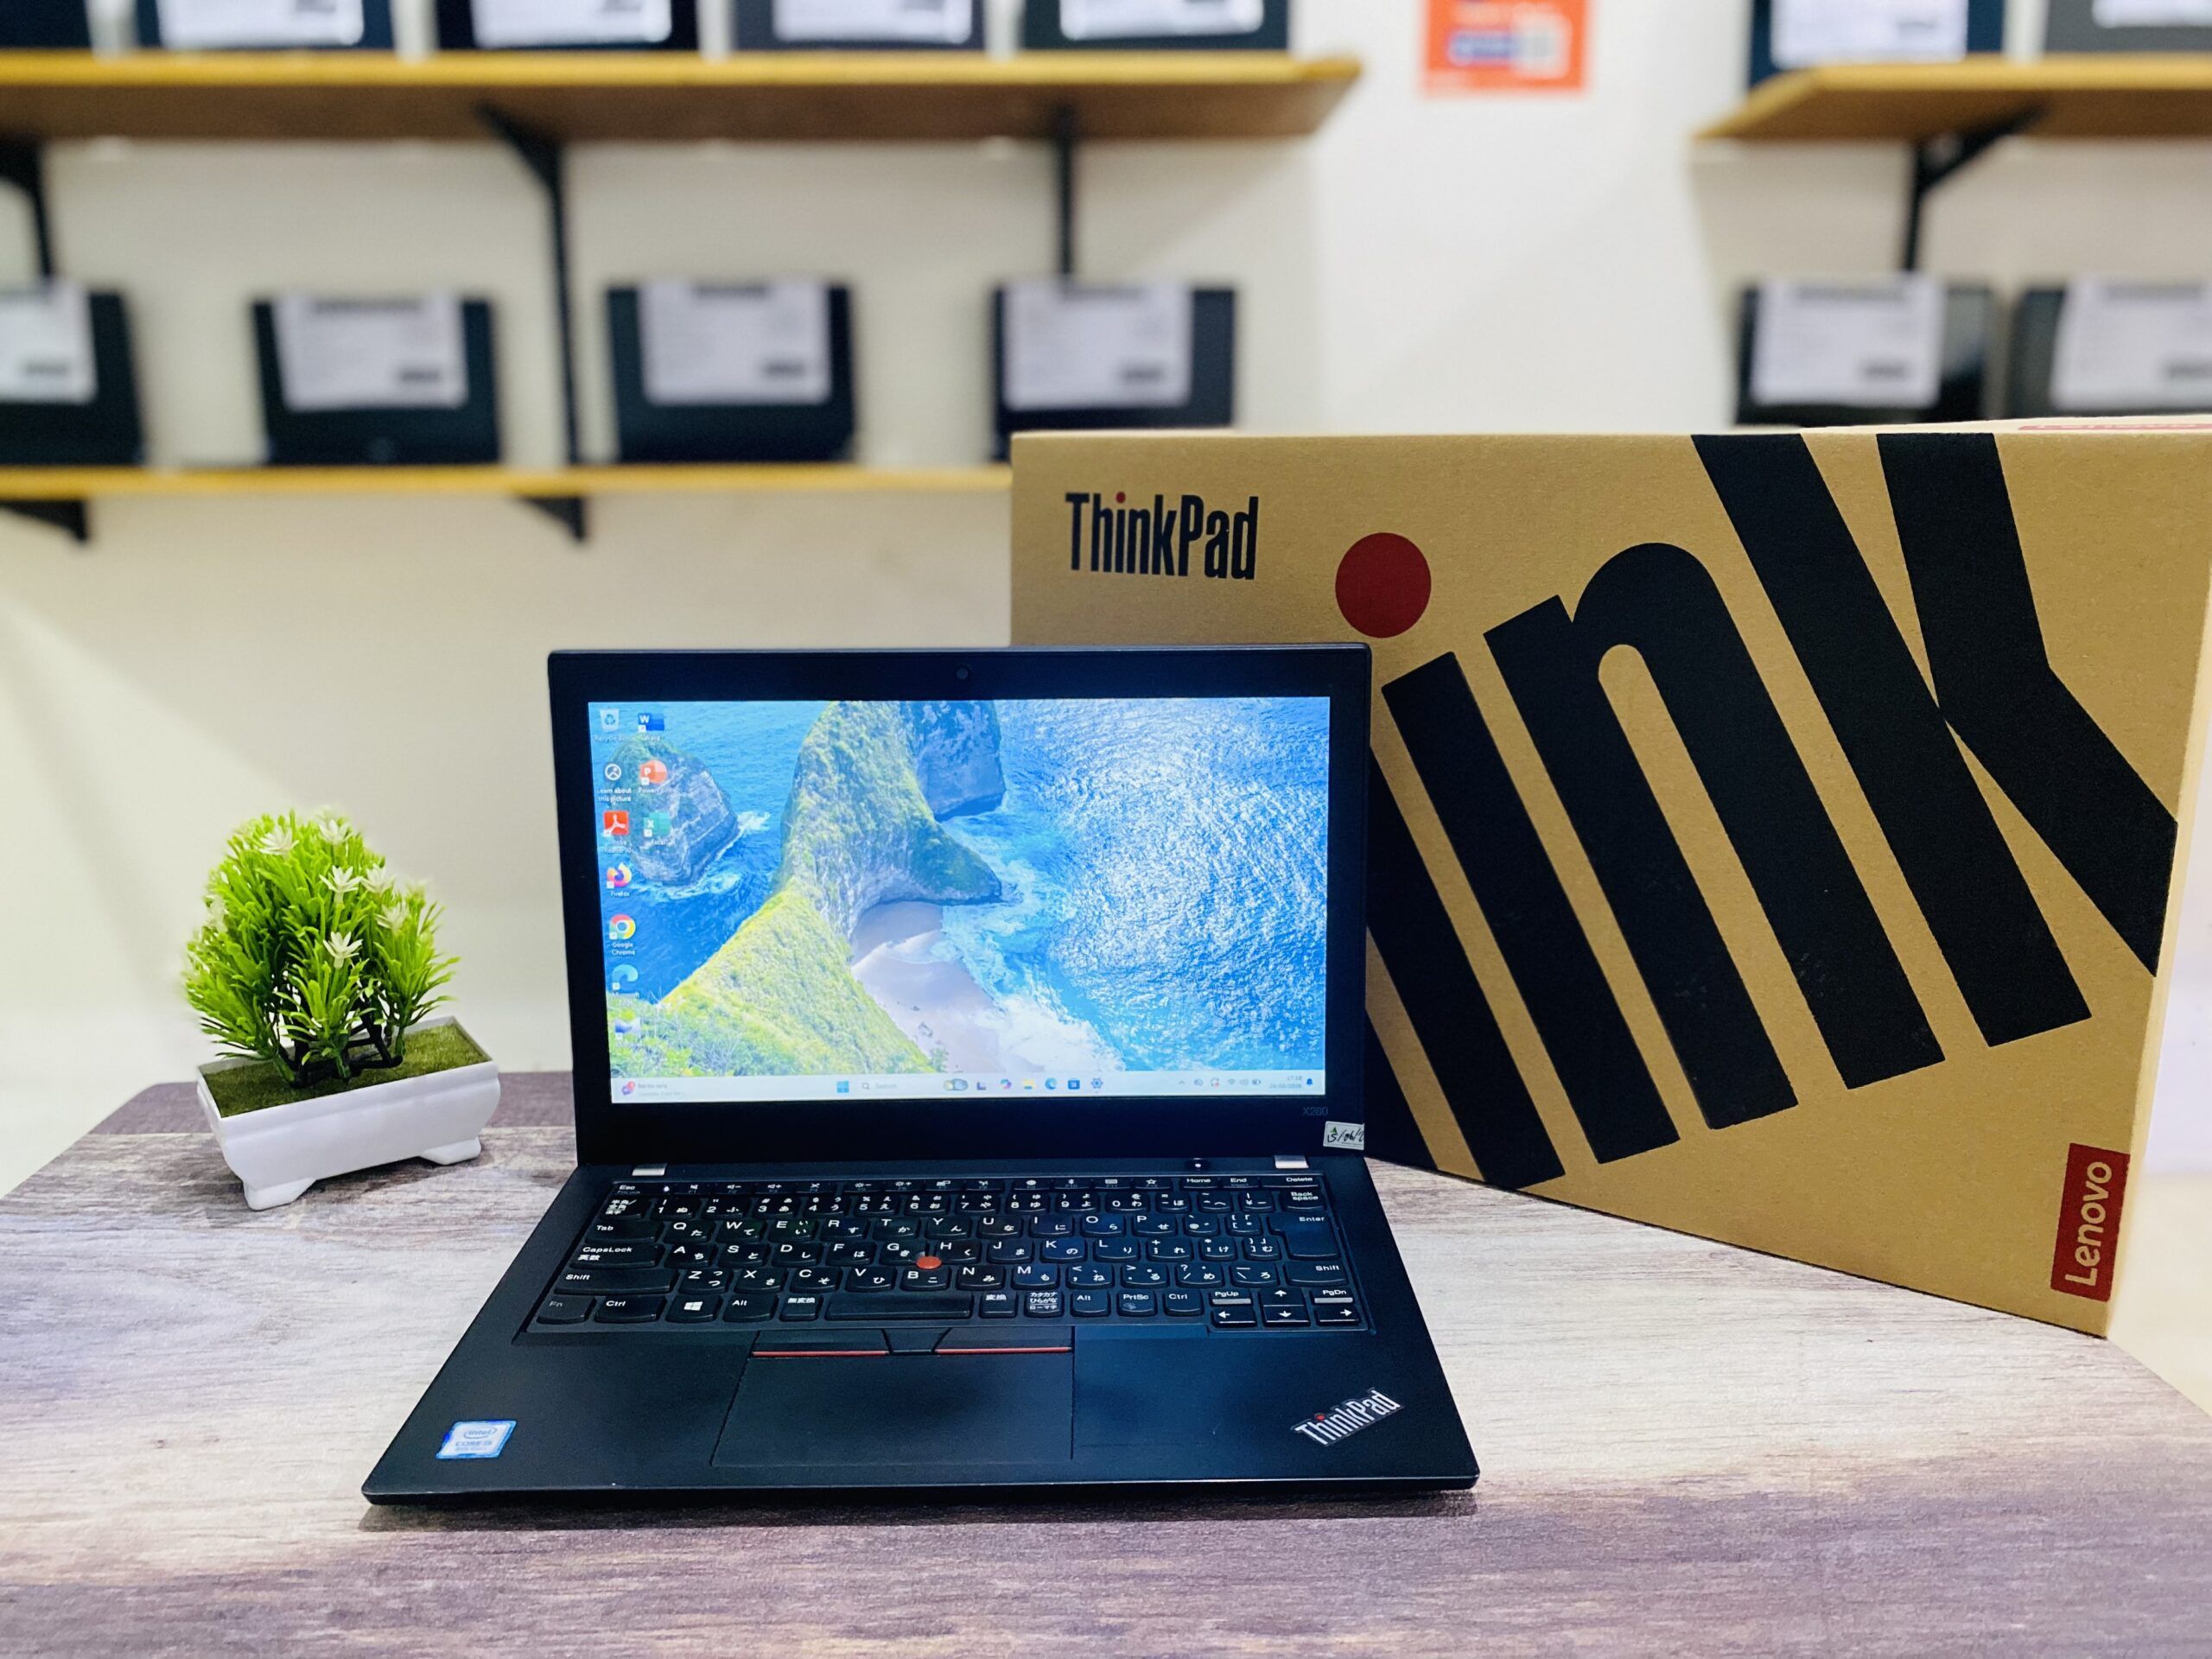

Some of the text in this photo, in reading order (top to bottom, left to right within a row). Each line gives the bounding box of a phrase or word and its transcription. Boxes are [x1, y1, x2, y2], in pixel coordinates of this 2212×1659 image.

[1065, 492, 1259, 580] ThinkPad
[1303, 1107, 1328, 1116] X280
[2064, 1161, 2113, 1287] Lenovo
[1294, 1388, 1402, 1446] ThinkPad
